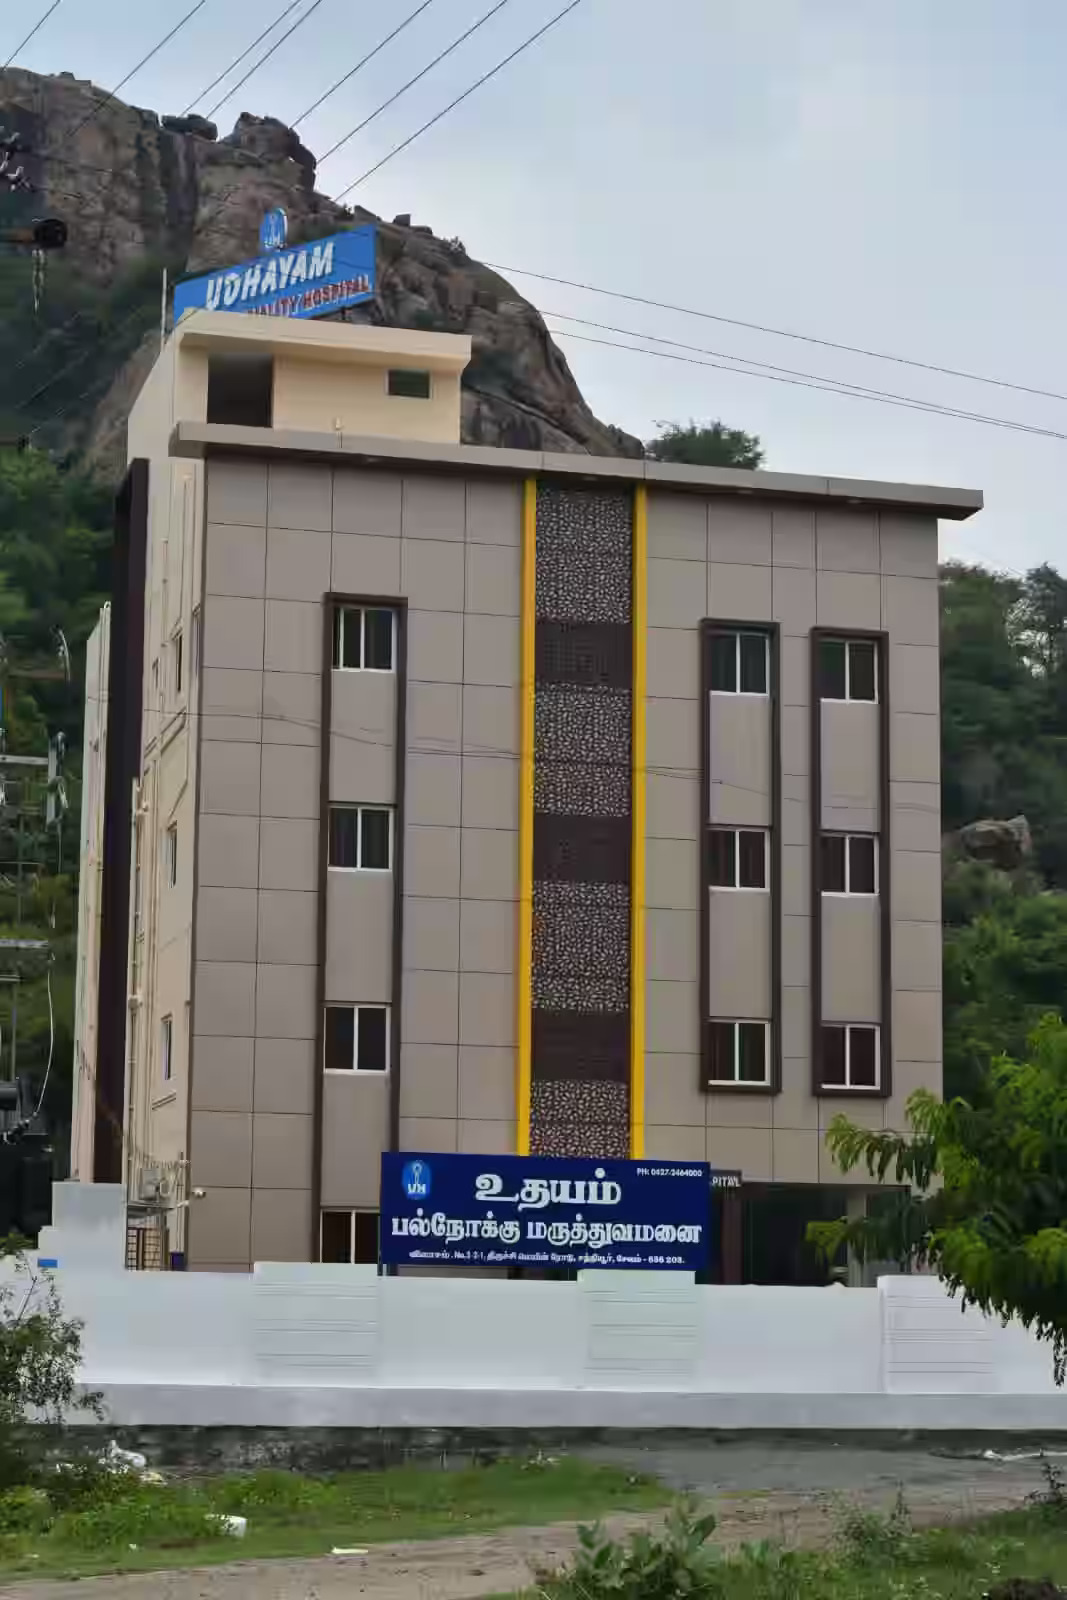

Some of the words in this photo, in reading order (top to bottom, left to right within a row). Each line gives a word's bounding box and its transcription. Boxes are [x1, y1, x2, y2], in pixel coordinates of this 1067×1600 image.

[206, 242, 334, 311] UDHAYAM
[303, 273, 370, 310] HOSPITAL
[475, 1167, 621, 1212] உதயம்
[391, 1207, 520, 1245] பல்நோக்கு
[526, 1213, 702, 1249] மருத்துவமனை
